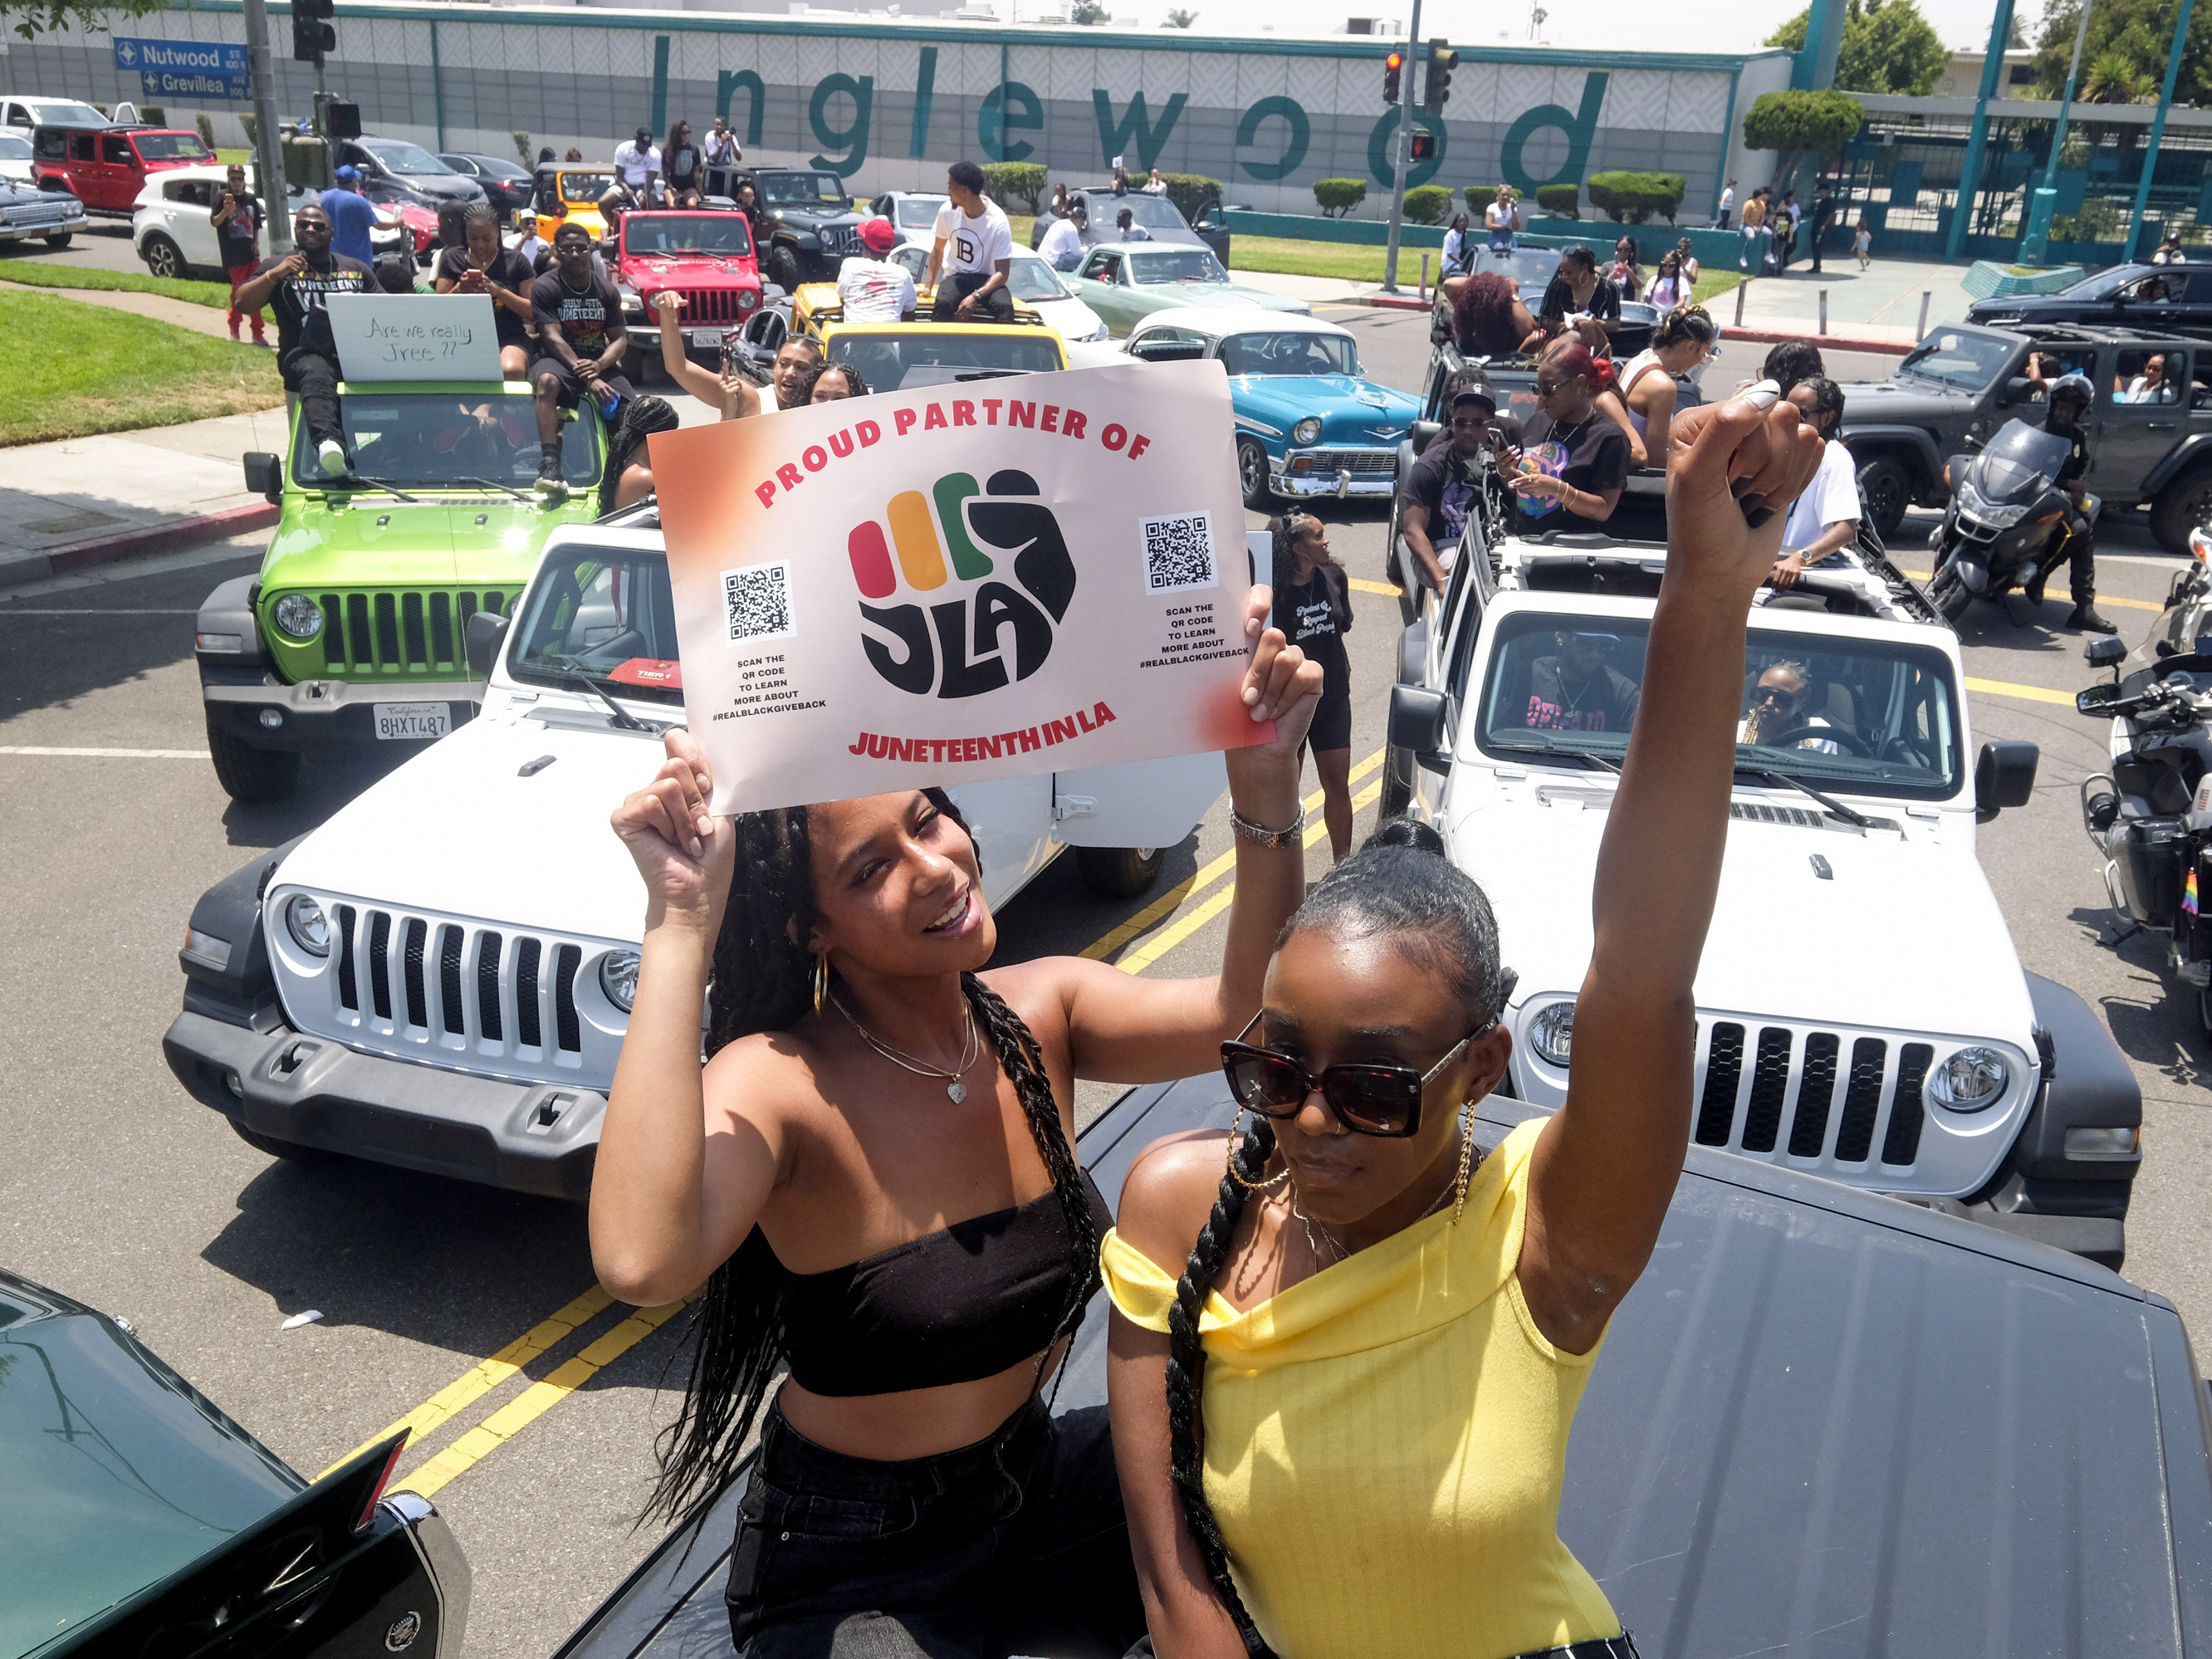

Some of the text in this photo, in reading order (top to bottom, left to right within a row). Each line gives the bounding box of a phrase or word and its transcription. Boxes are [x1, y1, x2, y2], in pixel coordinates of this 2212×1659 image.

[143, 46, 220, 67] Nutwood
[162, 73, 224, 93] Grevillea
[362, 317, 472, 345] Are we really
[441, 340, 457, 360] ??
[754, 399, 1151, 510] PROUD PARTNER OF
[1166, 604, 1214, 616] SCAN THE
[1320, 599, 1332, 612] &
[1172, 616, 1214, 629] QR CODE
[1184, 628, 1216, 639] LEARN
[1162, 639, 1225, 653] MORE ABOUT
[737, 654, 785, 668] SCAN THE
[1140, 648, 1250, 668] #REALBLACKGIVEBACK
[638, 670, 664, 678] TIER
[741, 667, 785, 680] QR CODE
[755, 679, 787, 690] LEARN
[734, 690, 799, 706] MORE ABOUT
[390, 706, 431, 717] California
[712, 700, 827, 722] #REALBLACKGIVEBACK
[380, 717, 445, 734] 8HXT487
[849, 701, 1117, 762] JUNETEENTH IN LA
